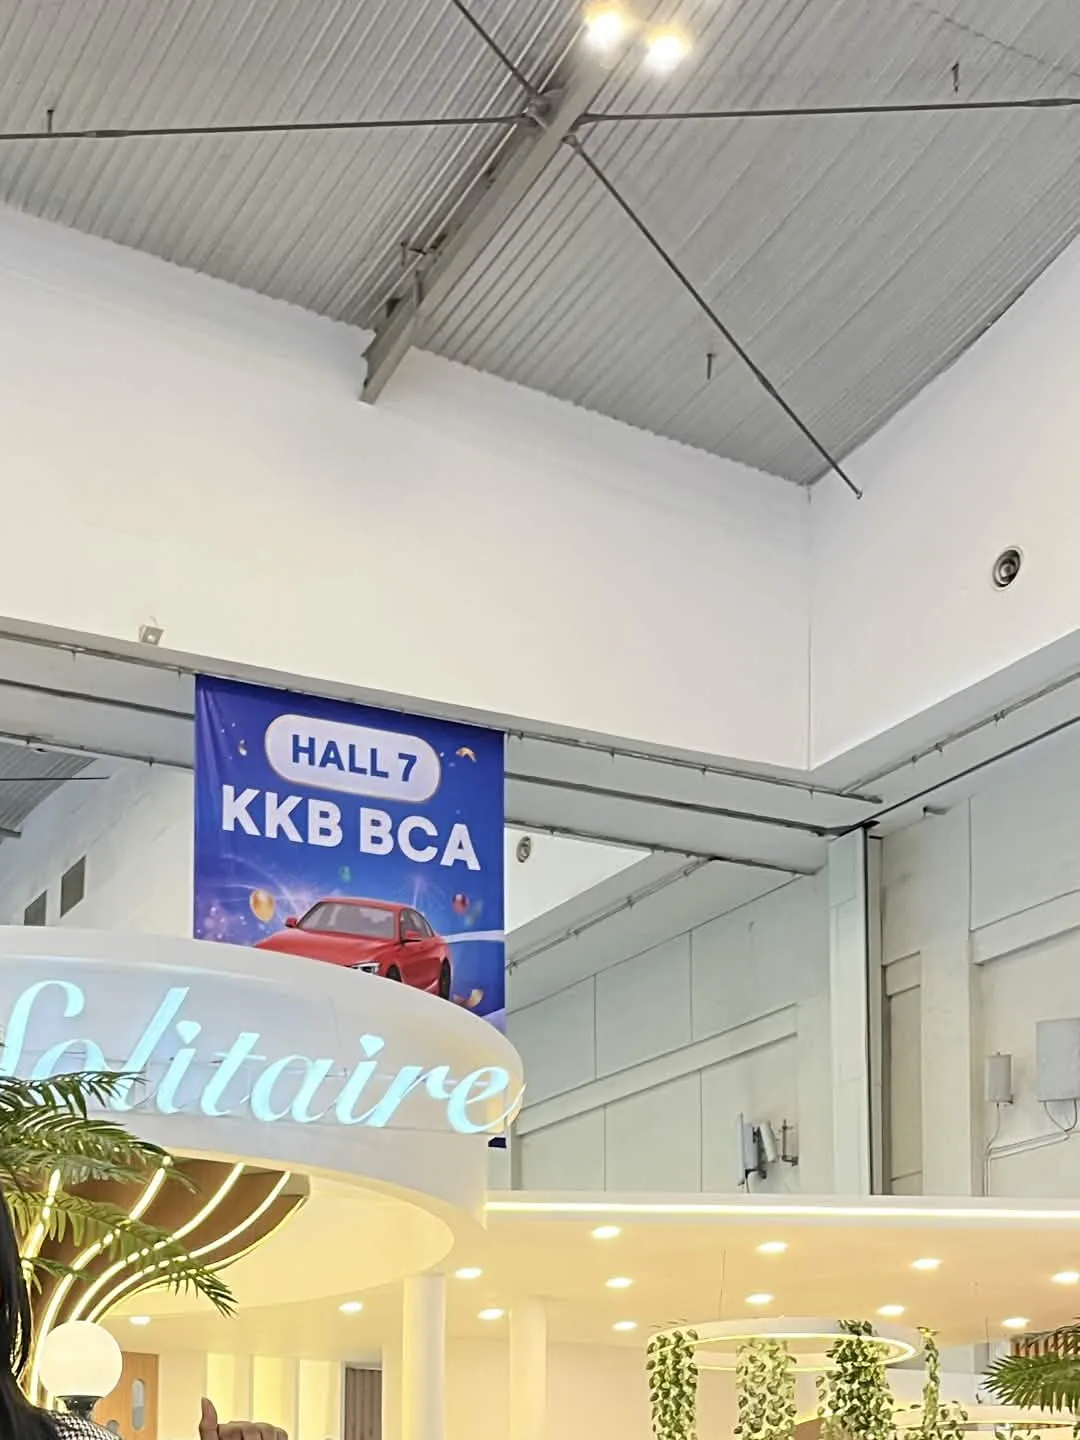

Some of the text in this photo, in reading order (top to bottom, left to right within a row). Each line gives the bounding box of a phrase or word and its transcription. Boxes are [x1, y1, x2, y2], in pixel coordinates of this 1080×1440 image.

[291, 734, 418, 782] HALL 7
[221, 784, 481, 871] KKB BCA
